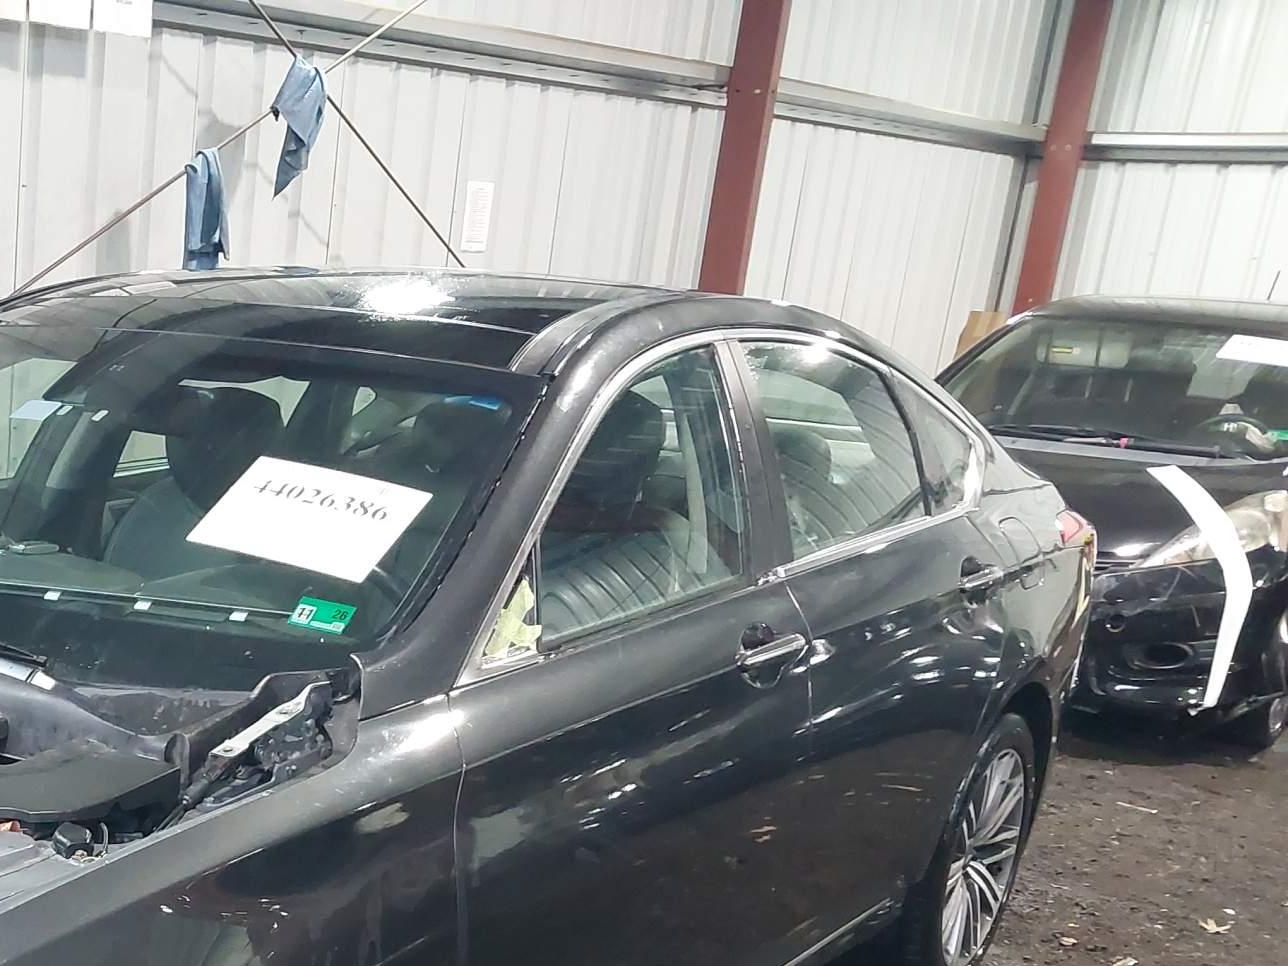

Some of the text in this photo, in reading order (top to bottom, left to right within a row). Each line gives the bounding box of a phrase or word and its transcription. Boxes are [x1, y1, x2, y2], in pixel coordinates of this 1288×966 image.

[253, 479, 388, 521] 44026386
[297, 607, 349, 621] 11 26
